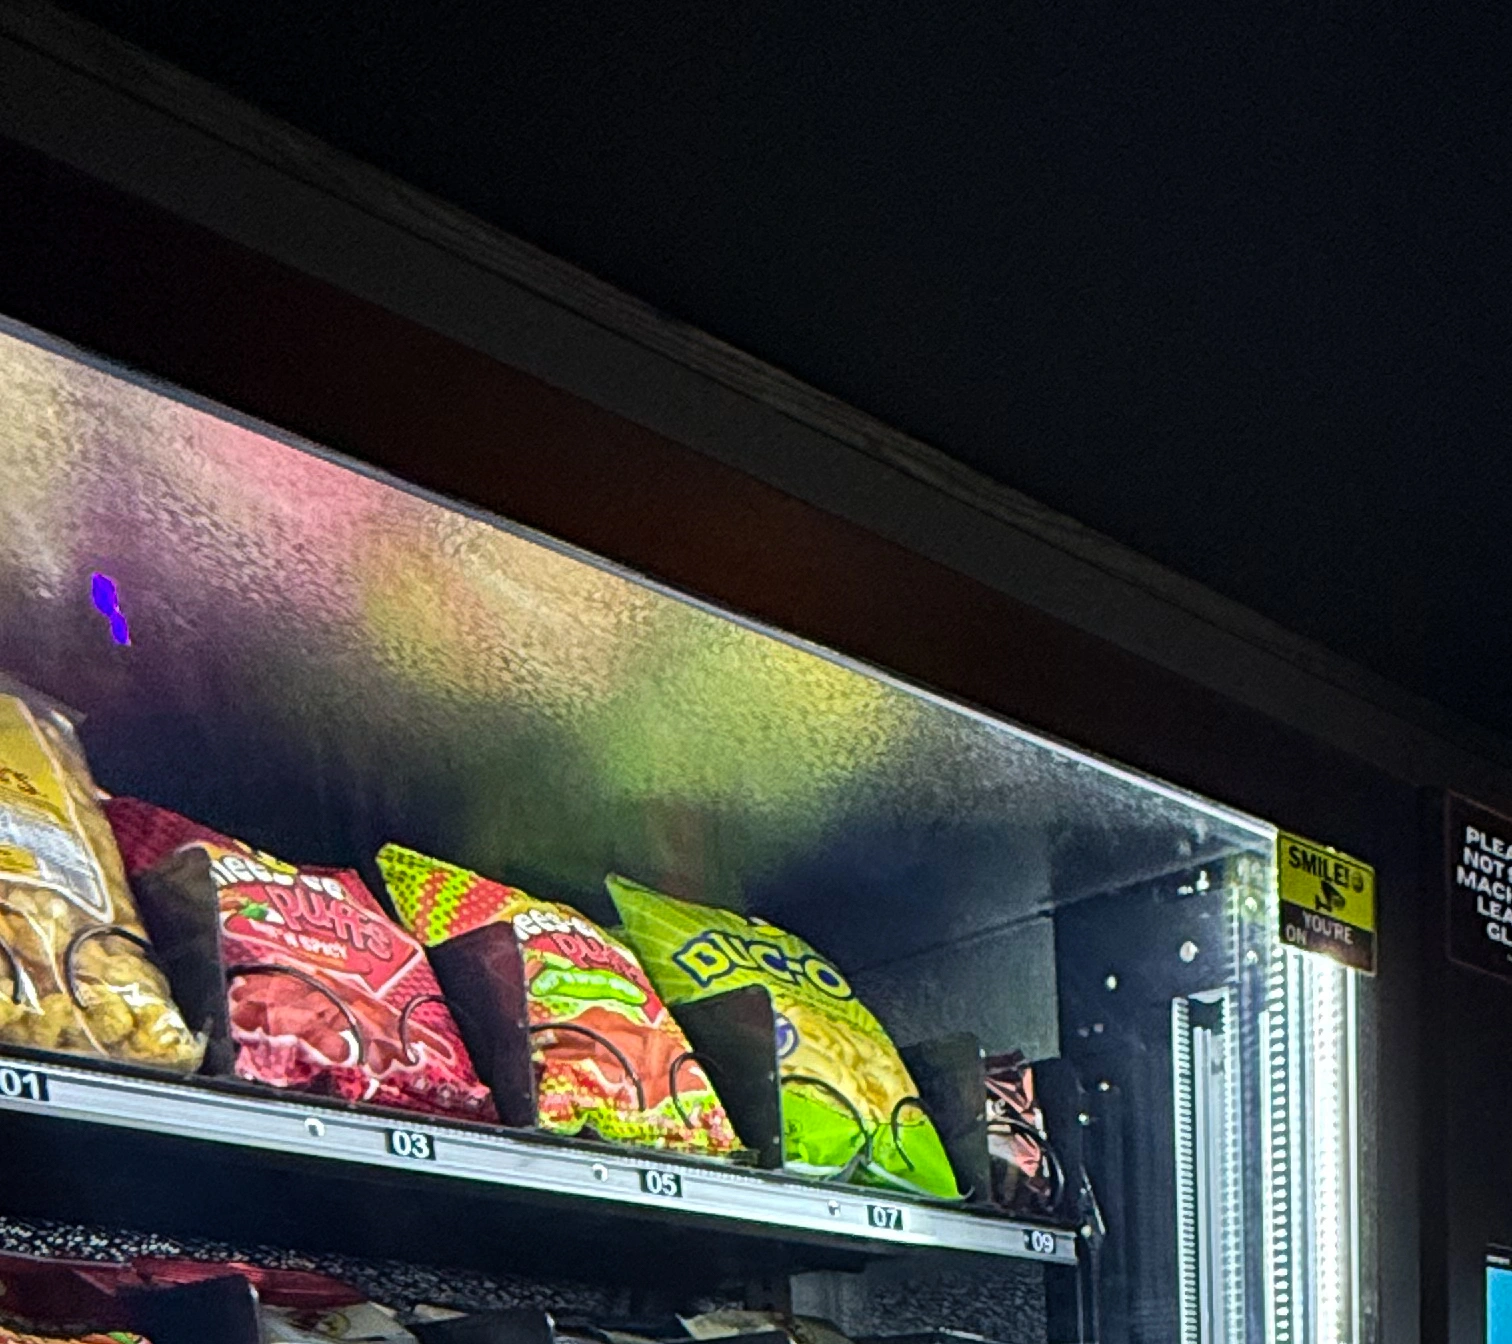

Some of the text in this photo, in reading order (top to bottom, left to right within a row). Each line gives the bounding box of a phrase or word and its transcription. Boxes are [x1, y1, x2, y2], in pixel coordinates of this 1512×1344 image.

[1288, 845, 1350, 889] SMILE!
[1463, 845, 1506, 876] NOT
[1302, 910, 1355, 945] YOU'RE
[391, 1130, 432, 1160] 03
[645, 1169, 678, 1196] 05
[872, 1205, 900, 1230] 07
[1030, 1230, 1055, 1254] 09
